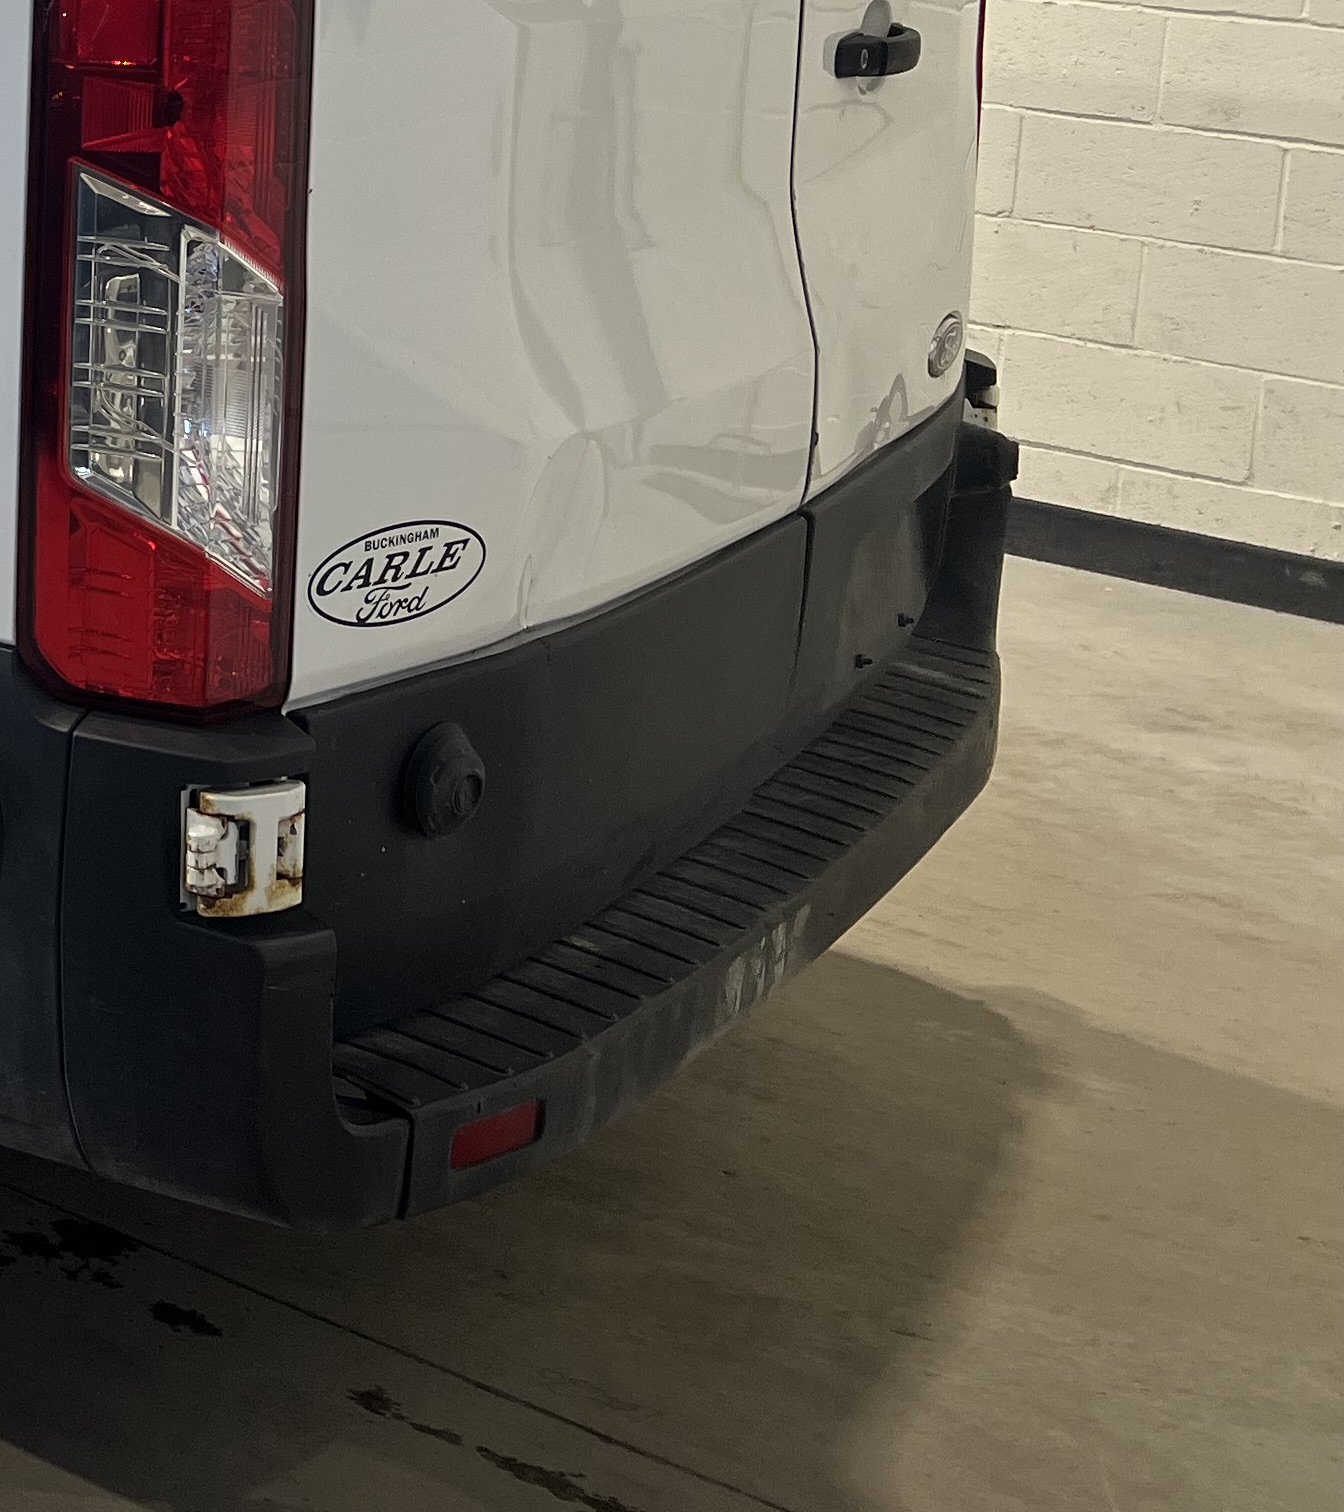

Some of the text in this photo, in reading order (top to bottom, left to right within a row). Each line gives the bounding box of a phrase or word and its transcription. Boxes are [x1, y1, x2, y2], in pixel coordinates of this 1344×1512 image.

[363, 527, 441, 553] BUCKINGHAM
[315, 538, 472, 597] CARLE
[356, 582, 430, 624] Ford
